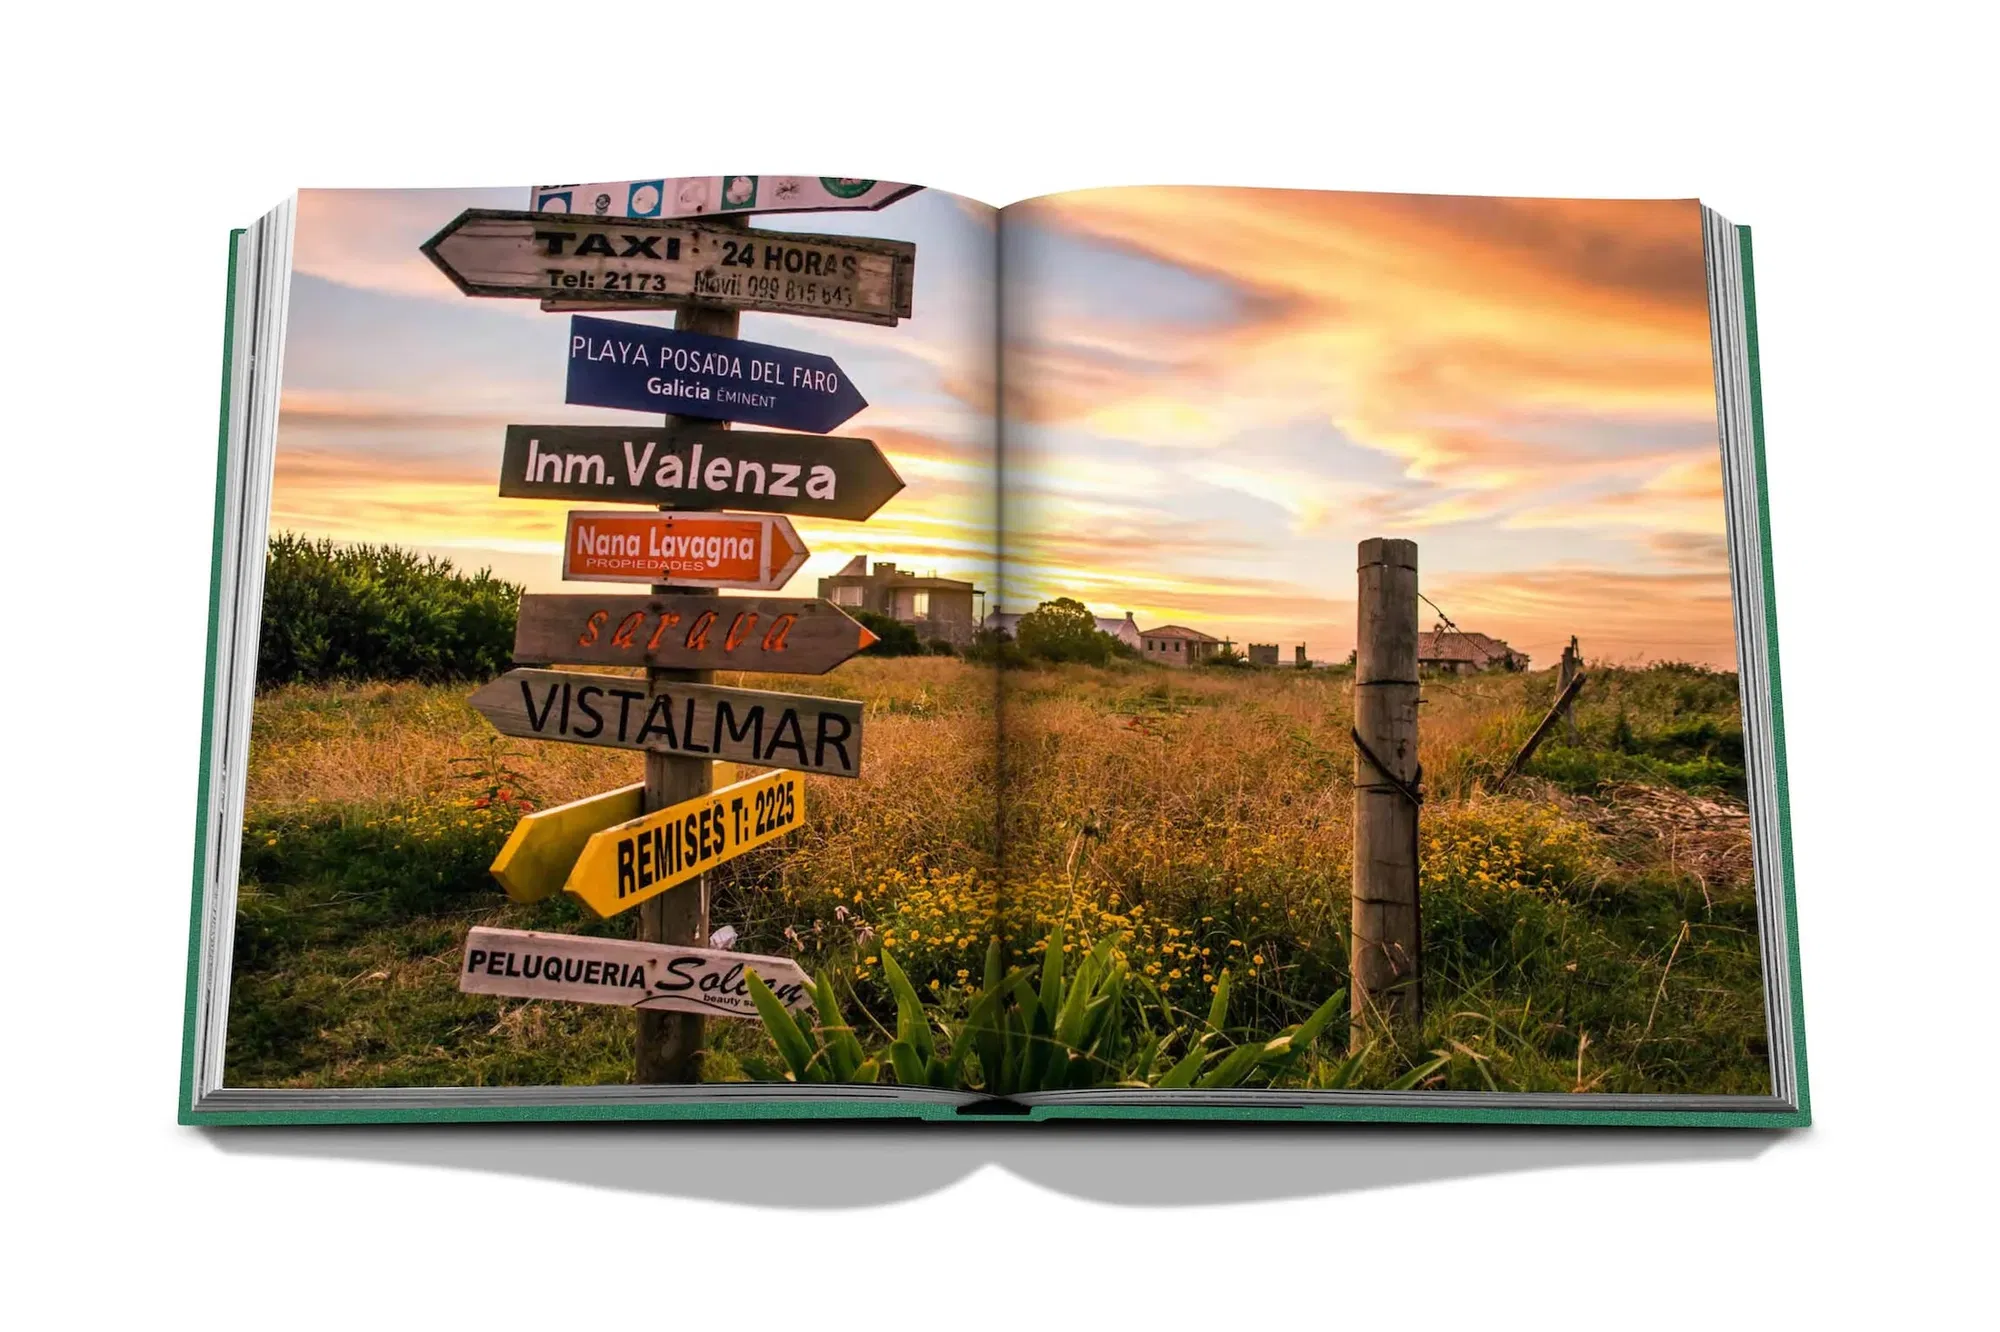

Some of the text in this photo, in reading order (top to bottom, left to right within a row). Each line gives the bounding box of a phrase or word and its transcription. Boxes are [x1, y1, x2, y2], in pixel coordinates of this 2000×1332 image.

[536, 231, 681, 260] TAXI
[721, 241, 858, 280] 24 HORAS
[547, 269, 667, 291] Tel: 2173
[571, 336, 838, 394] PLAYA POSADA DEL FARO
[647, 376, 711, 401] Galicia
[525, 439, 837, 501] Inm. Valenza
[577, 525, 754, 567] Nana Lavagna
[586, 558, 705, 572] PROPIEDADES
[577, 609, 799, 652] sarava
[520, 680, 853, 772] VISTALMAR
[617, 779, 796, 899] REMISES T: 2225
[467, 949, 647, 989] PELUQUERIA
[703, 993, 741, 1007] beauty
